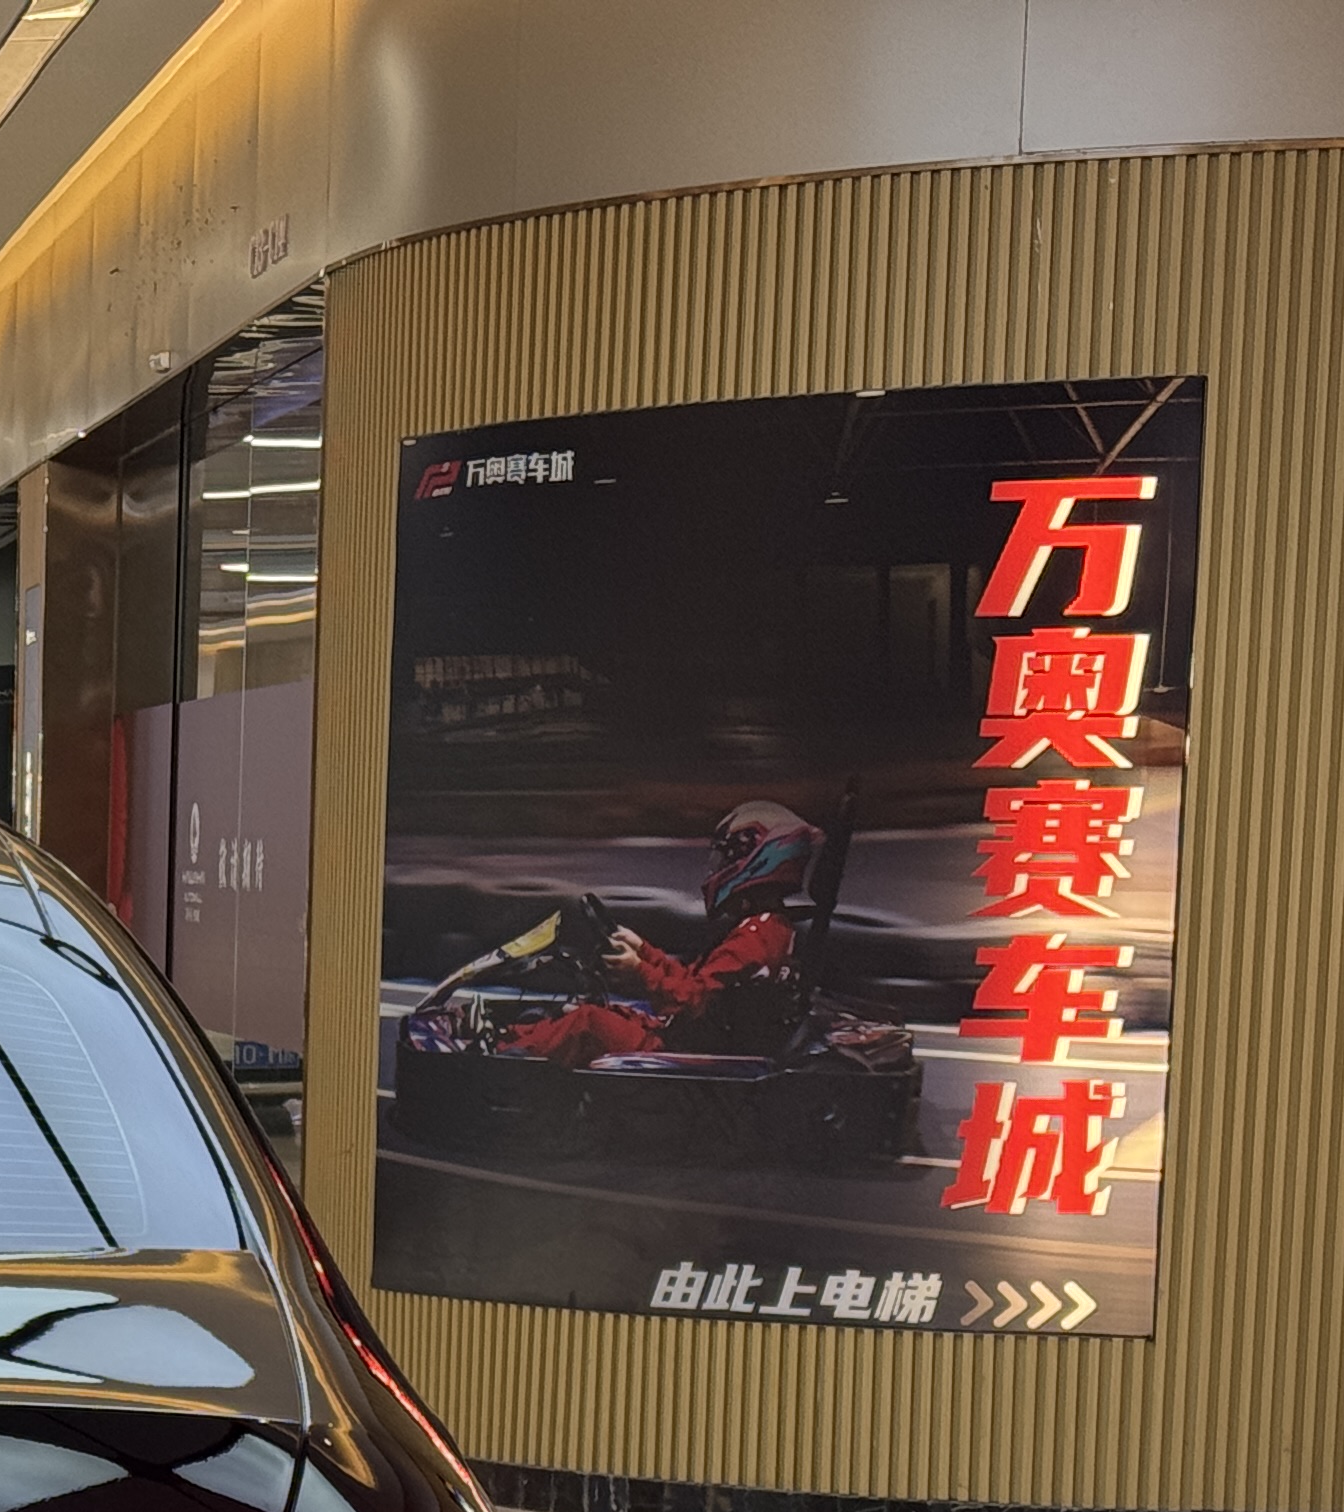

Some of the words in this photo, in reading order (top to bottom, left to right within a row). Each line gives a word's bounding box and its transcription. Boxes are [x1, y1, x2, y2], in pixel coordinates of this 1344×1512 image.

[466, 450, 574, 487] 万奥赛车城
[940, 475, 1158, 1216] 万奥赛车城
[650, 1261, 942, 1323] 由此上电梯
